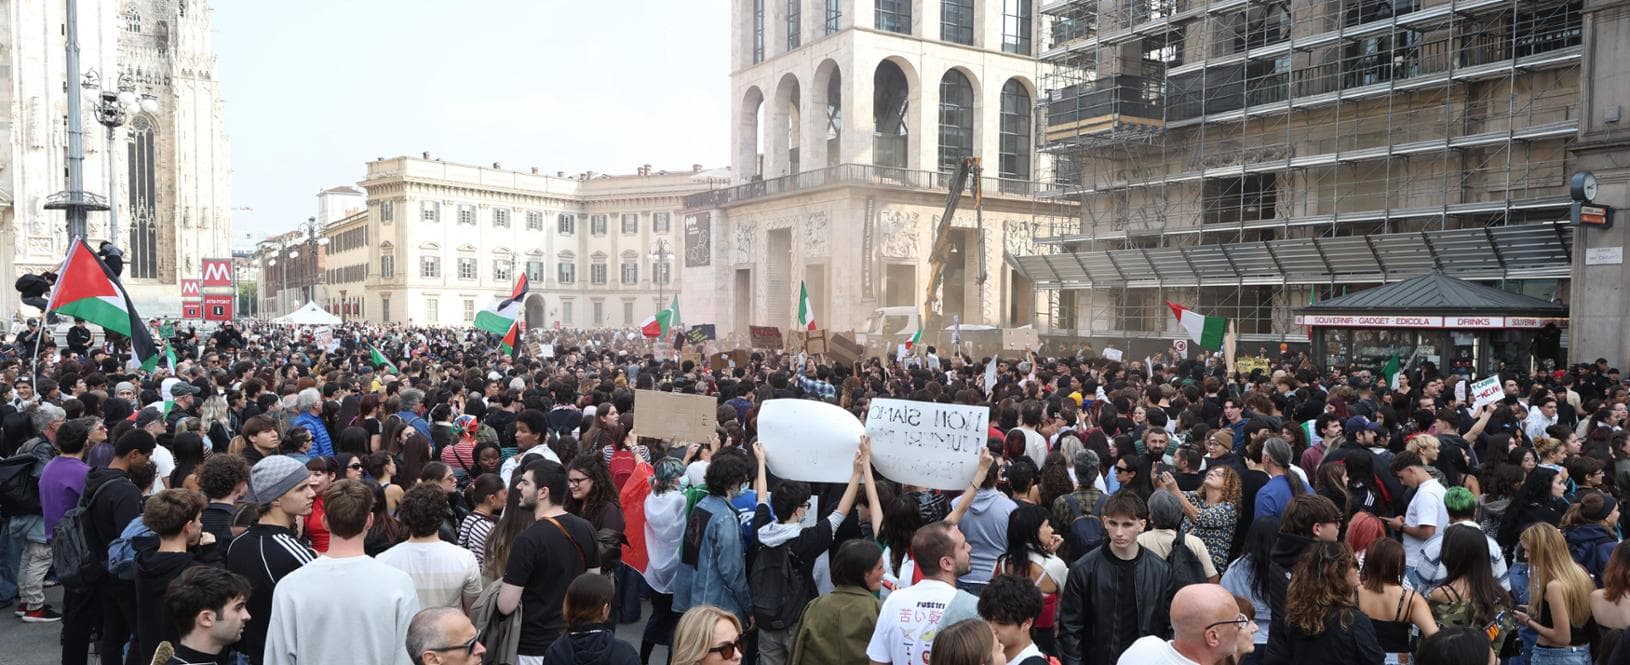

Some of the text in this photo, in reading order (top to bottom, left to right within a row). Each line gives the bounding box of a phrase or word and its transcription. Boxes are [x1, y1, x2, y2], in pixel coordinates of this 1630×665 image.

[204, 263, 231, 281] M
[183, 282, 199, 293] M
[1359, 317, 1389, 325] GADGET
[1396, 317, 1430, 325] EDICOLA
[1457, 318, 1490, 326] DRINKS
